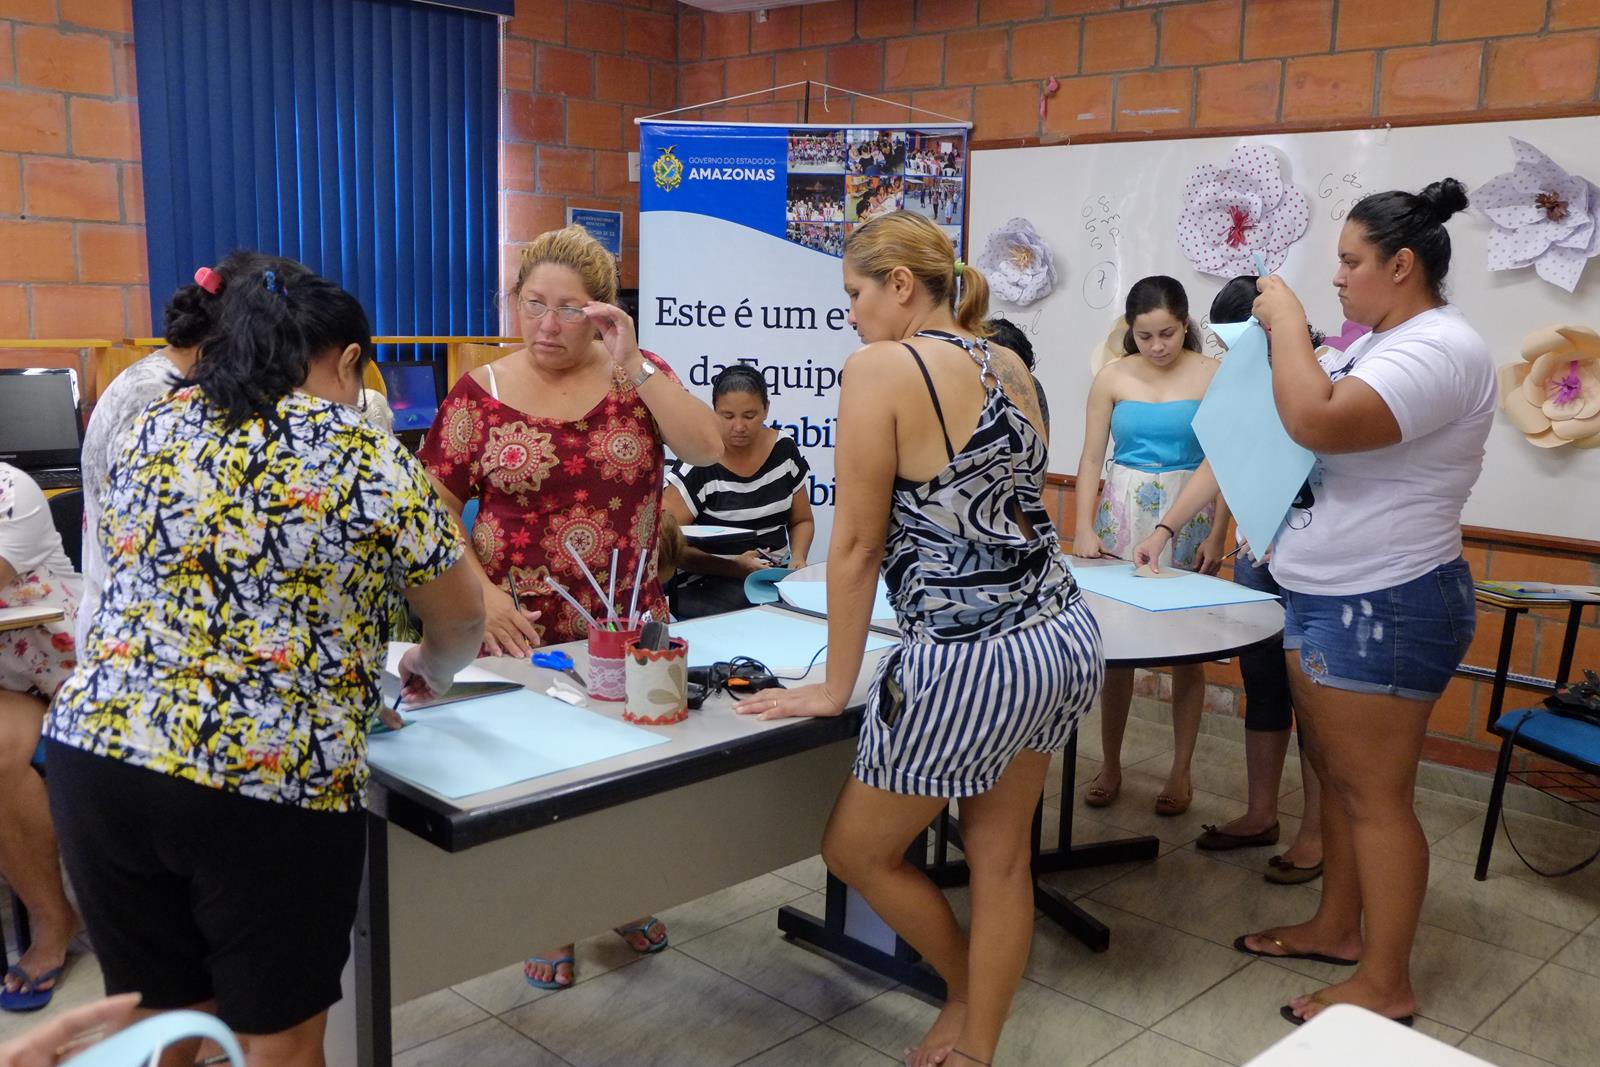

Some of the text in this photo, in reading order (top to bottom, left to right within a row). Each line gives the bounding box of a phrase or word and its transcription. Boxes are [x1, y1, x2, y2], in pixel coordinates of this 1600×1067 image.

[736, 157, 763, 165] ESTADO
[688, 167, 776, 181] AMAZONAS
[655, 296, 726, 328] Este
[734, 298, 753, 328] é
[761, 306, 818, 330] um
[737, 358, 844, 396] quip
